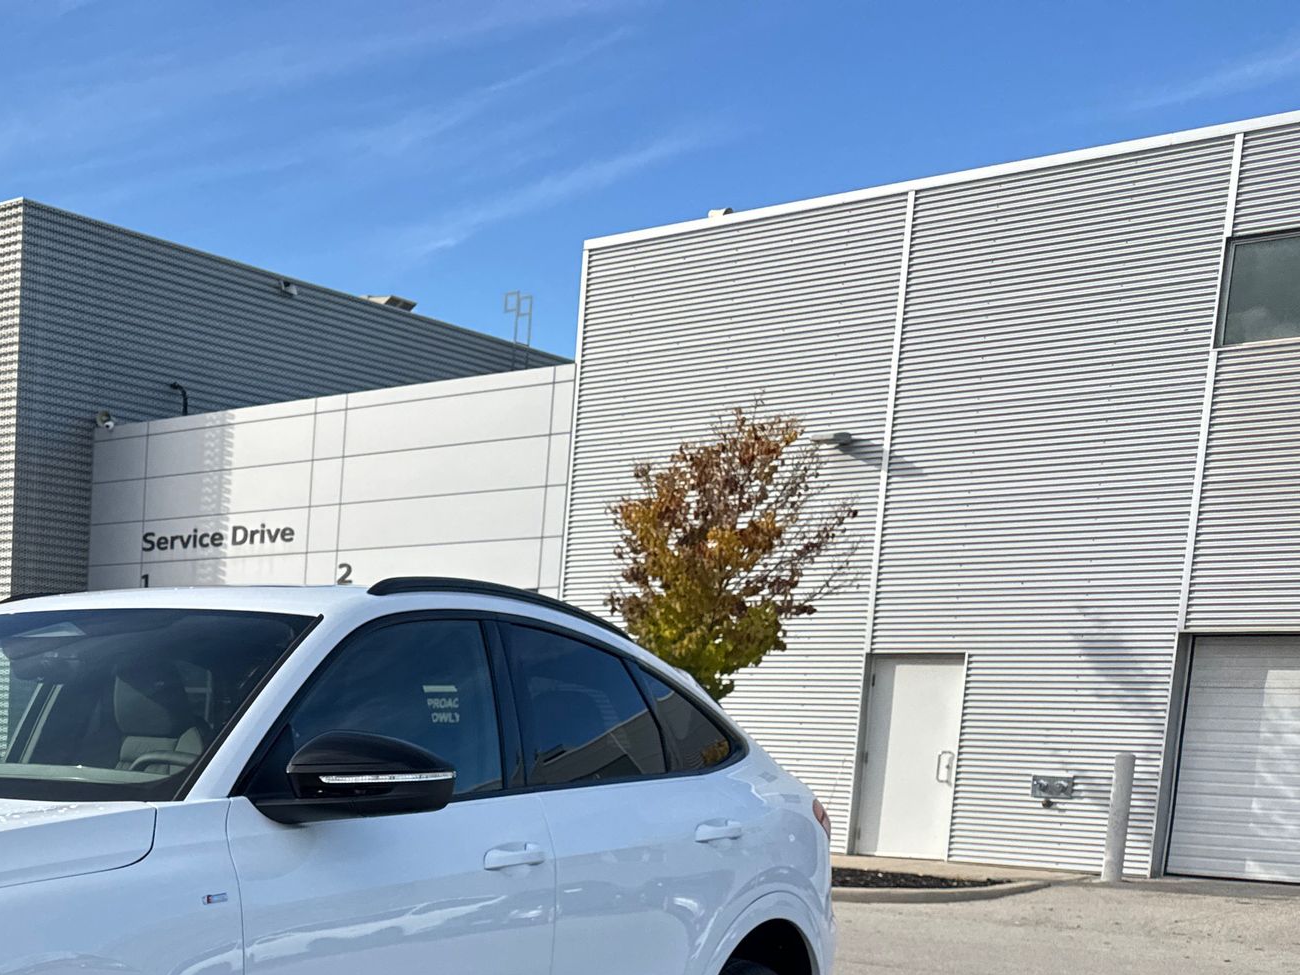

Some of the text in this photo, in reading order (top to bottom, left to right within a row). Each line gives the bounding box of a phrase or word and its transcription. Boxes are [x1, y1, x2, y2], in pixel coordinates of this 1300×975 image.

[142, 523, 295, 552] Service Drive
[141, 574, 150, 588] 1
[337, 563, 353, 585] 2
